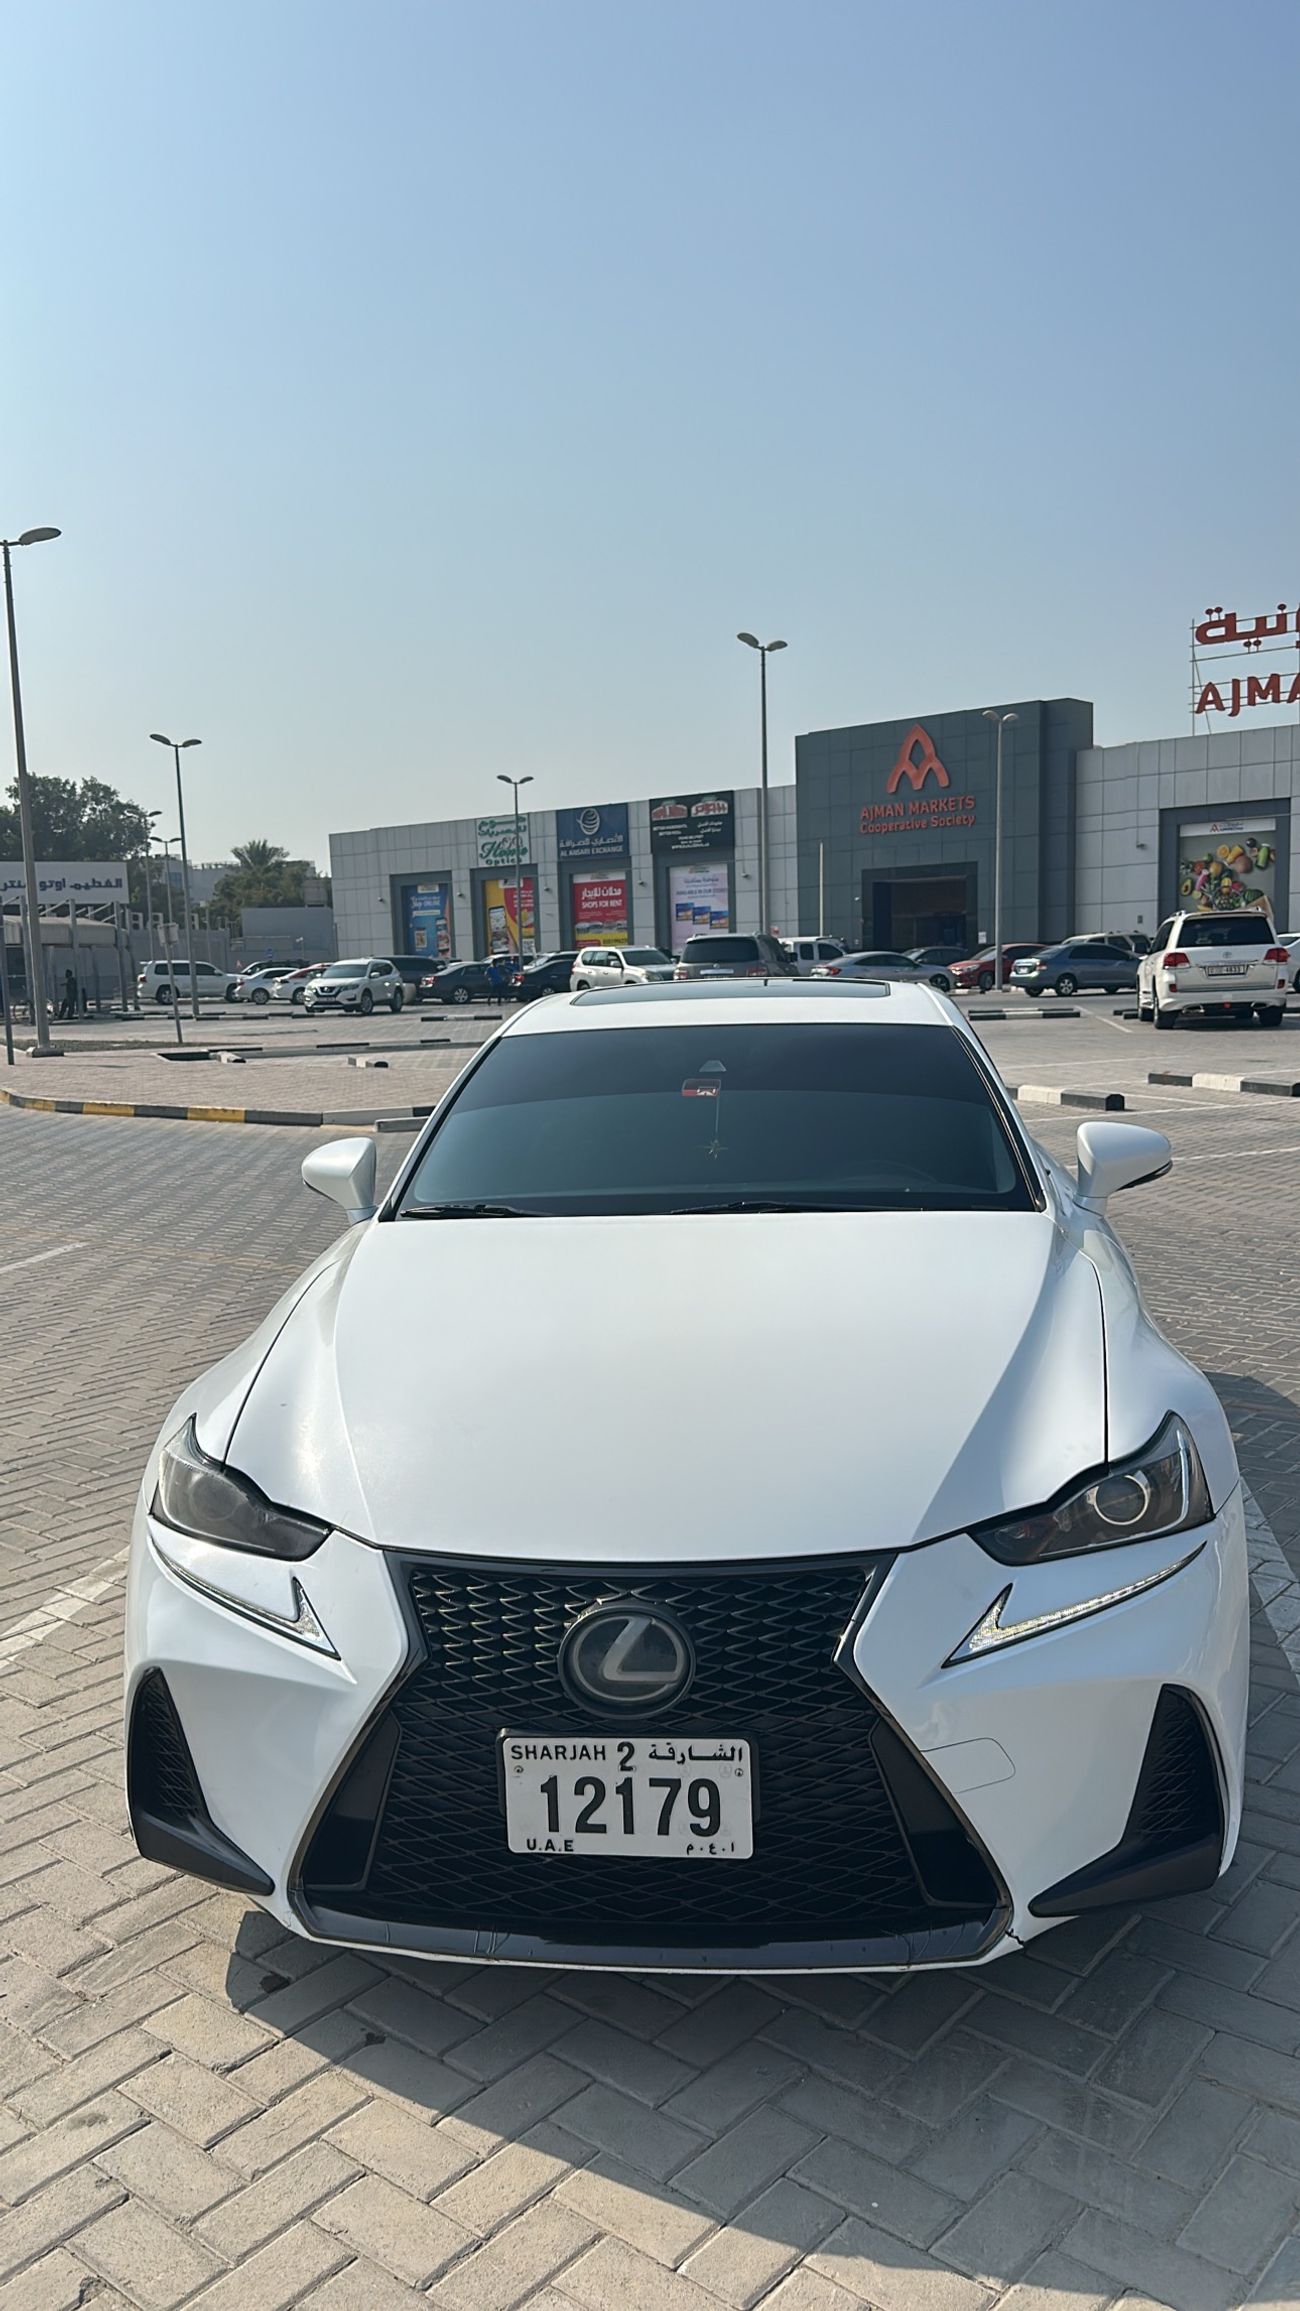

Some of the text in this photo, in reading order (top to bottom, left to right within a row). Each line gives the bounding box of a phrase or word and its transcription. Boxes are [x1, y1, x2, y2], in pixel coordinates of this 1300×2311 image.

[860, 795, 975, 821] AJMAN MARKETS
[860, 814, 976, 835] Cooperative Society
[479, 840, 528, 859] Home
[582, 901, 598, 909] SHOPS
[511, 1741, 743, 1772] SHARJAH 2 الشارقة
[540, 1775, 721, 1837] 12179
